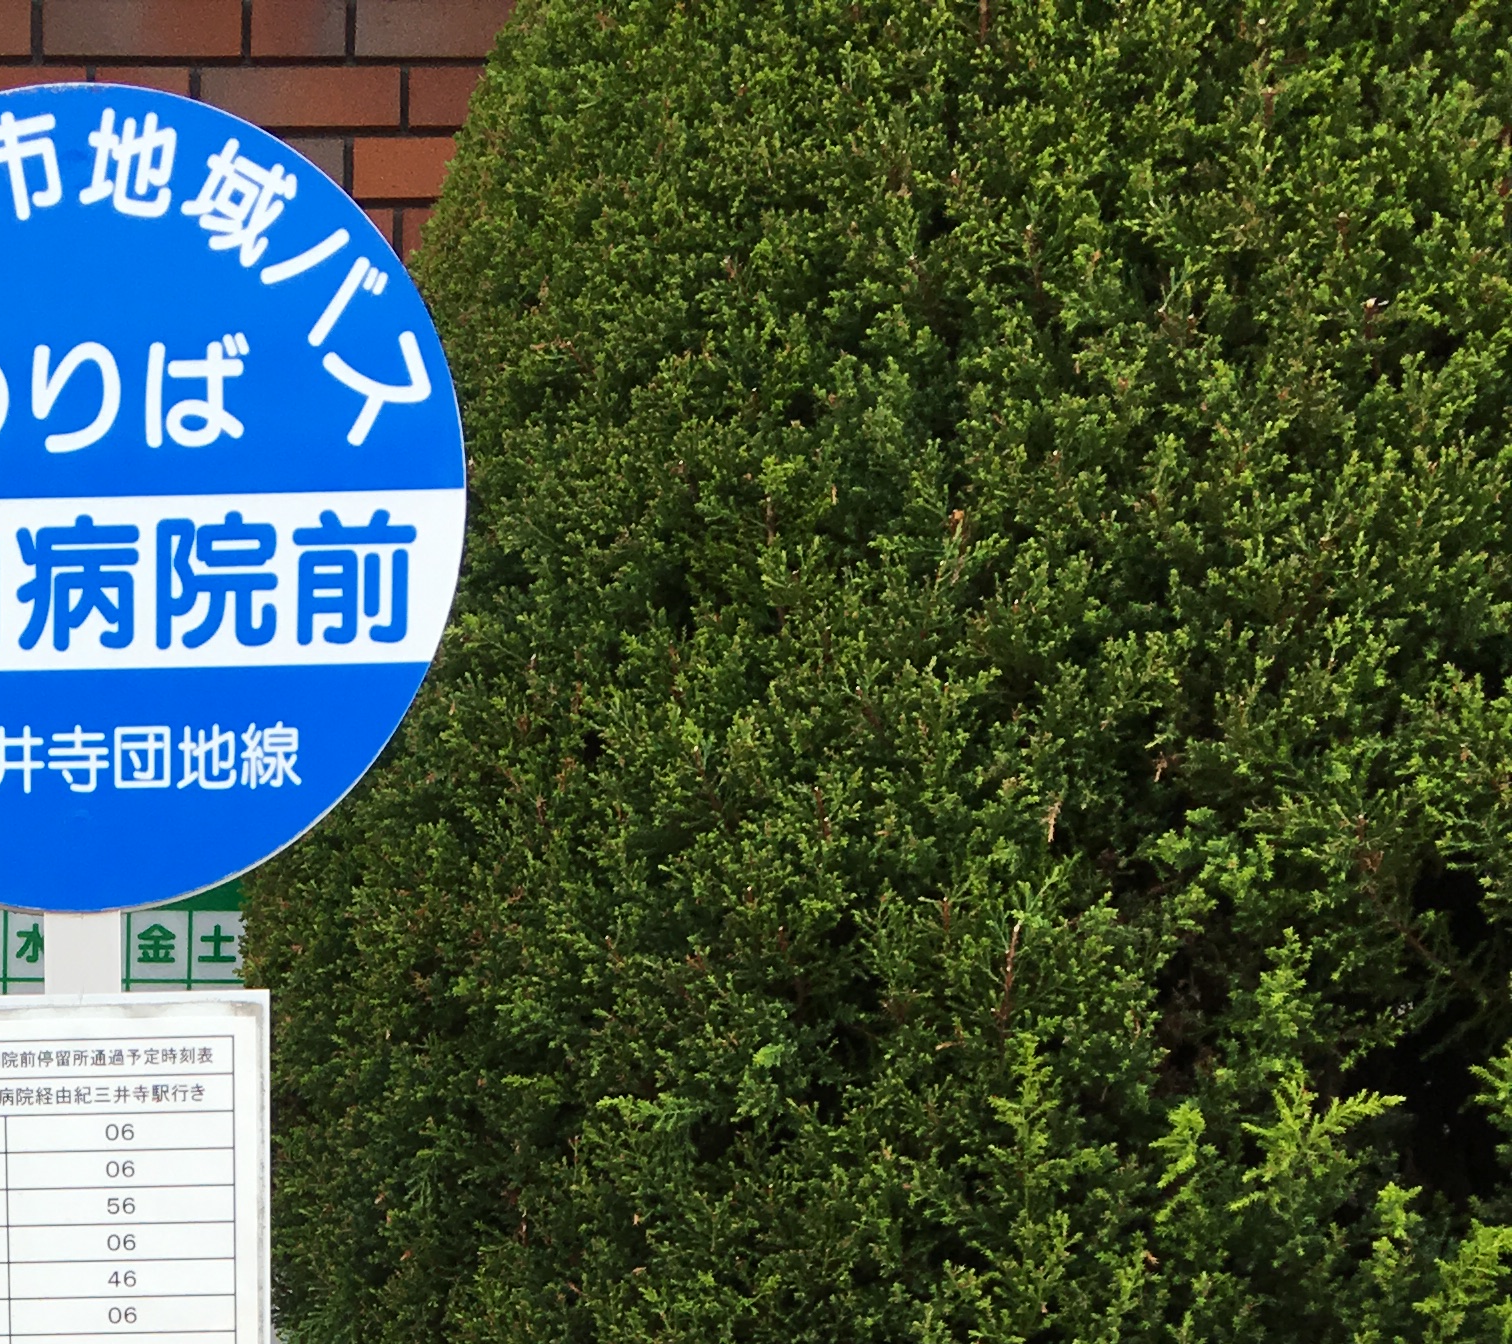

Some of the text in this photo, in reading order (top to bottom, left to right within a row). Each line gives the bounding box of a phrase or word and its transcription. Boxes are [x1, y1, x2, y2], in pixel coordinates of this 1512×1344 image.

[137, 923, 176, 963] 金
[197, 923, 237, 963] 土
[105, 1123, 135, 1141] 06
[106, 1160, 136, 1178] 06
[107, 1197, 136, 1215] 56
[107, 1233, 137, 1252] 06
[108, 1270, 137, 1288] 46
[108, 1306, 138, 1324] 06
